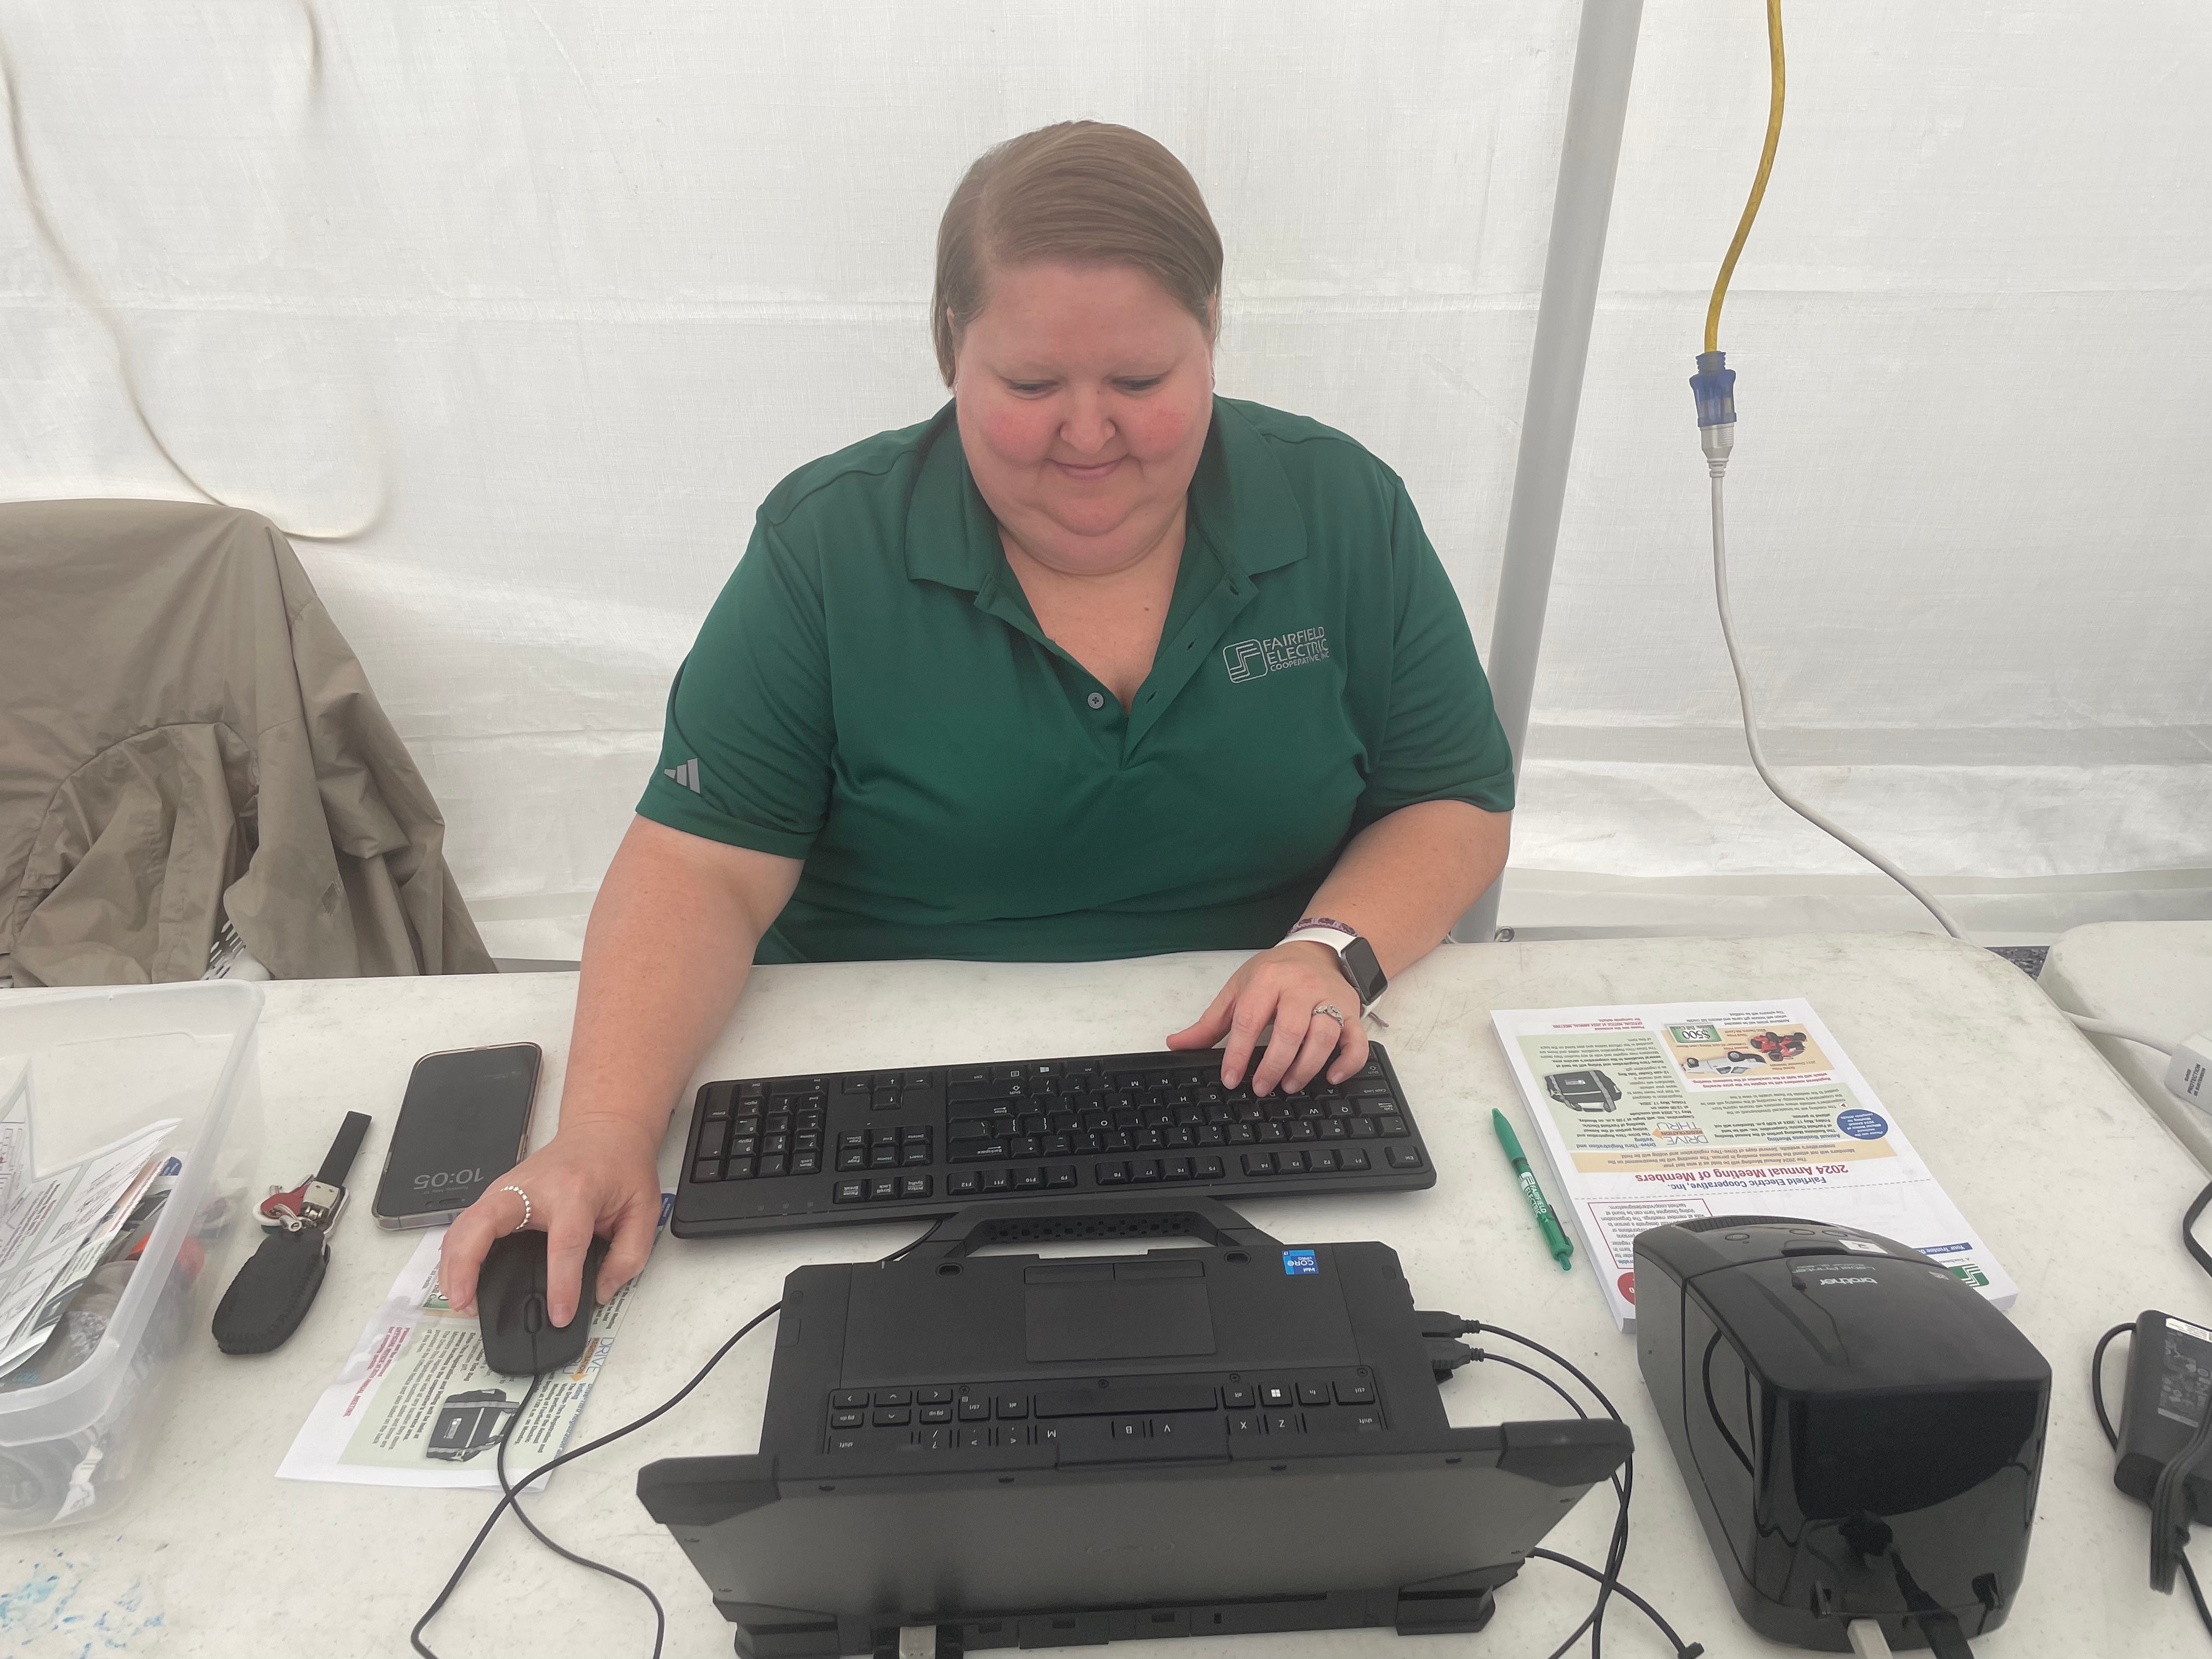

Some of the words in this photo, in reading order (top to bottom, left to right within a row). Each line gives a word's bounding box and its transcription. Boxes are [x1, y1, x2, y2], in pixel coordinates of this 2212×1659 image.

[1262, 626, 1325, 652] FAIRFIELD
[1266, 638, 1329, 665] ELECTRIC
[1682, 1030, 1711, 1039] $500
[2187, 1063, 2200, 1094] PROTECTION
[1656, 1121, 1701, 1130] THRU
[1662, 1135, 1709, 1145] DRIVE
[1713, 1169, 1767, 1179] Meeting
[1768, 1166, 1813, 1177] Annual
[1815, 1165, 1848, 1174] 2024
[413, 1168, 484, 1189] 10:05
[1635, 1172, 1696, 1182] Members
[1697, 1171, 1711, 1180] of
[1687, 1180, 1747, 1189] Cooperative,
[1786, 1177, 1827, 1185] Fairfield
[1530, 1186, 1547, 1213] FAIRFIELD
[585, 1338, 614, 1374] DRIVE
[1240, 1421, 1248, 1430] X
[1278, 1419, 1285, 1427] Z
[1125, 1425, 1132, 1434] B
[1163, 1424, 1171, 1432] V
